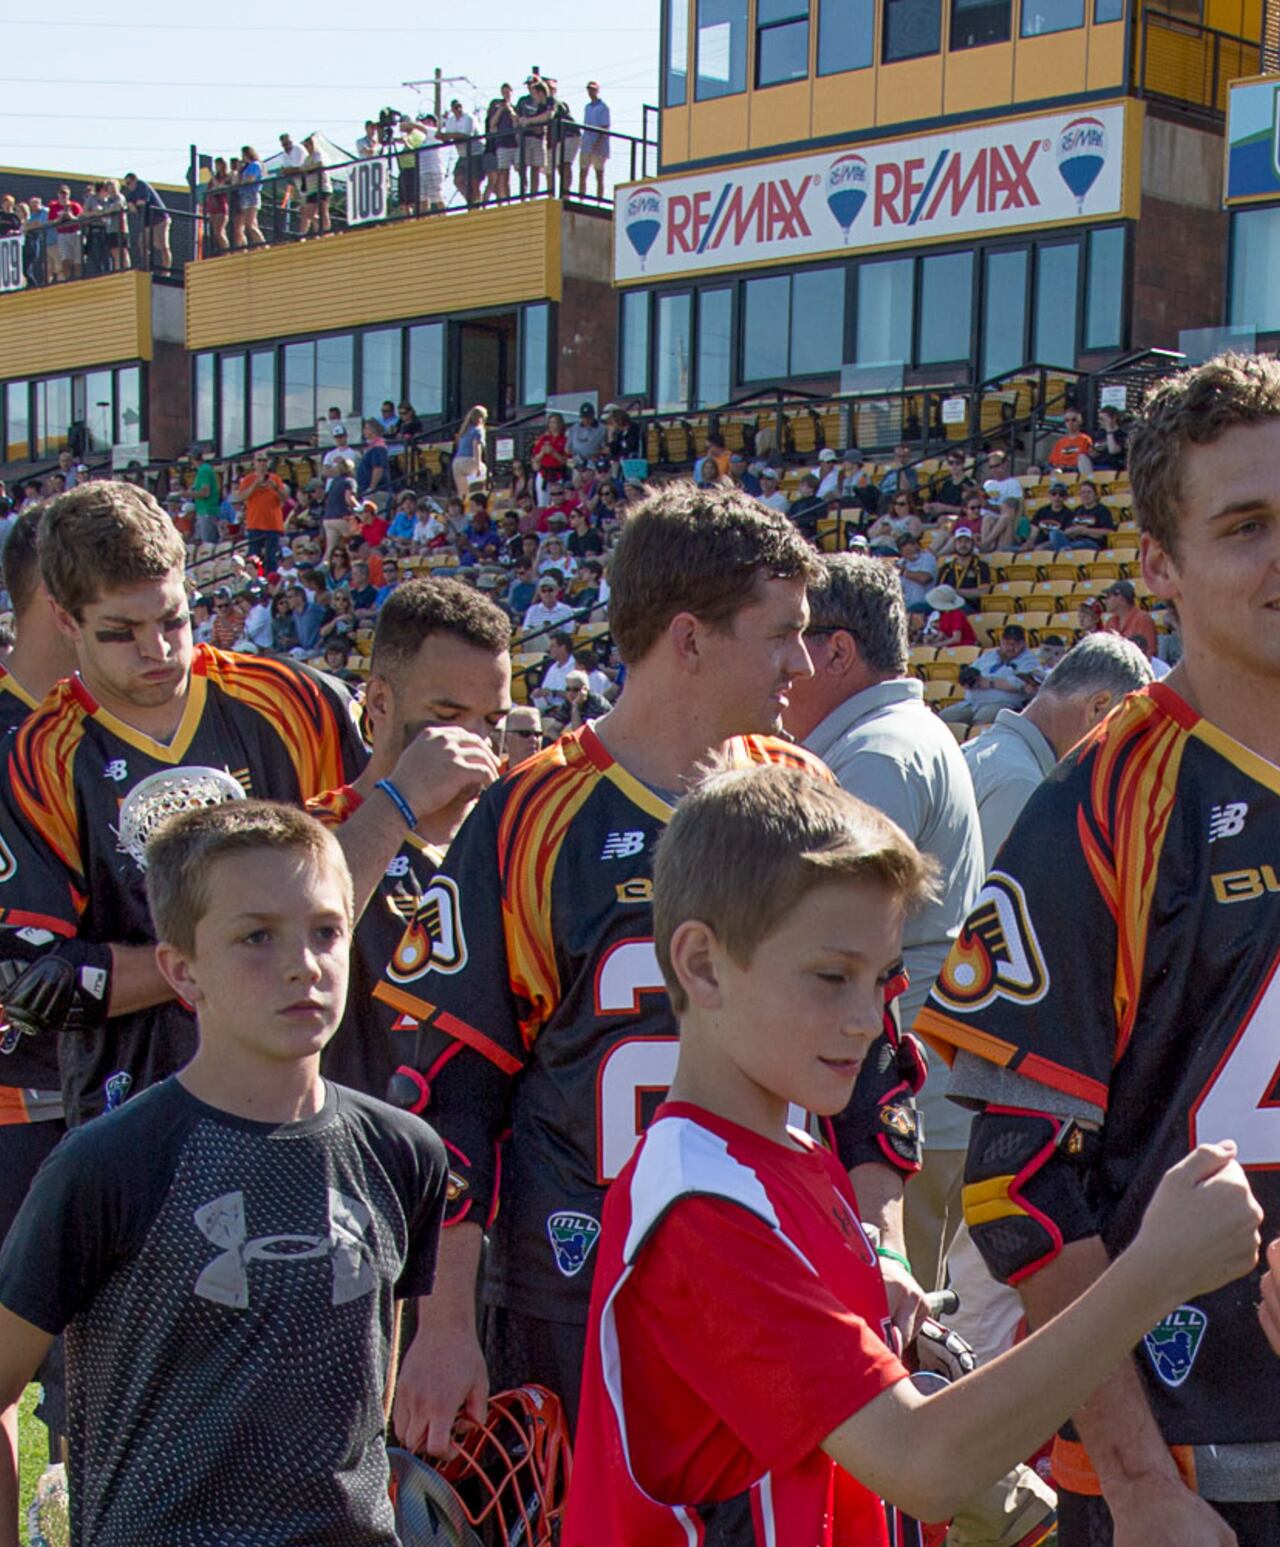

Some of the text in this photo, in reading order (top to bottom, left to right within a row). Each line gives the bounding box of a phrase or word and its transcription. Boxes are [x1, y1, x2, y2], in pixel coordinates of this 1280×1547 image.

[349, 161, 384, 221] 108
[666, 174, 814, 255] RE/MAX
[873, 138, 1043, 227] RE/MAX
[553, 1216, 598, 1232] MLL
